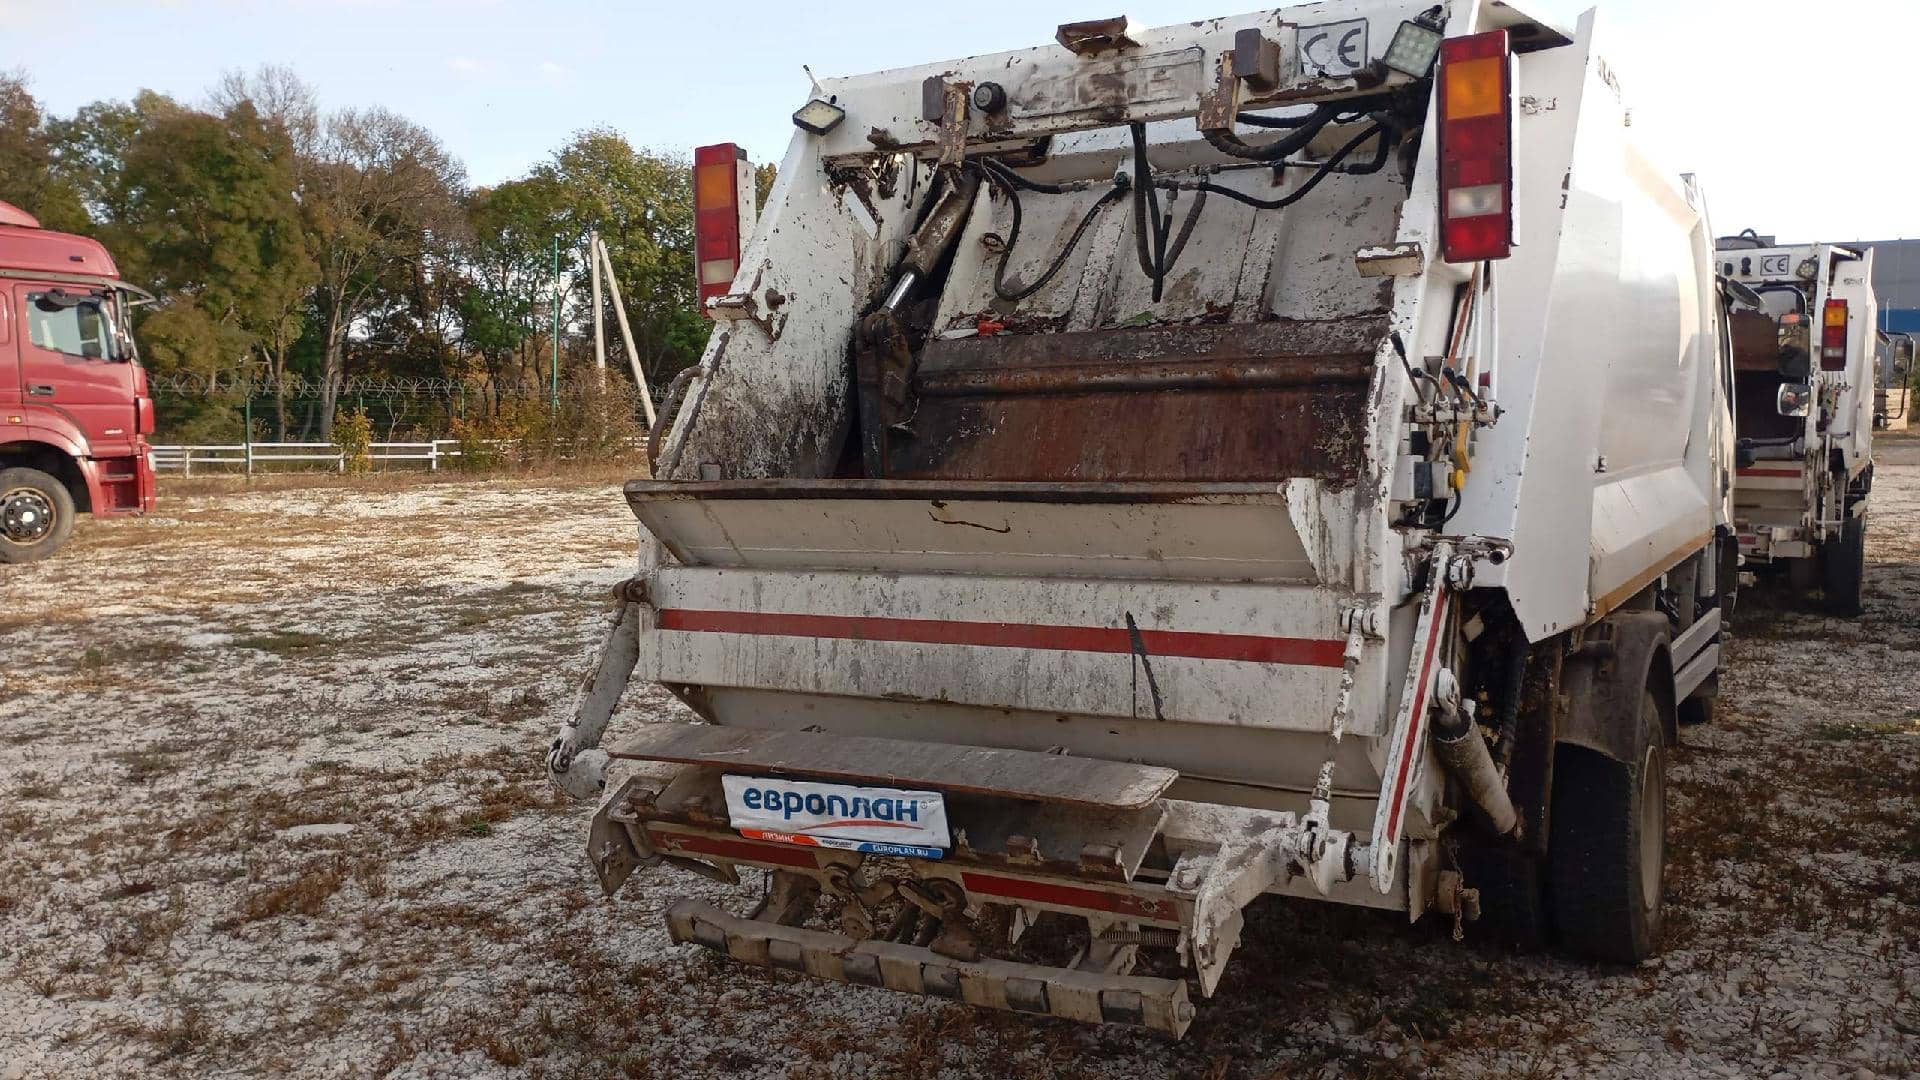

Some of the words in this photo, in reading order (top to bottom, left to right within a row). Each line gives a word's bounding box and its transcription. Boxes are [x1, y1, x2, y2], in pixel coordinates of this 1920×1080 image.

[1303, 28, 1361, 71] CE
[1764, 257, 1787, 273] CE
[742, 787, 918, 822] европлан
[872, 844, 929, 856] EUROPLAN.RU
